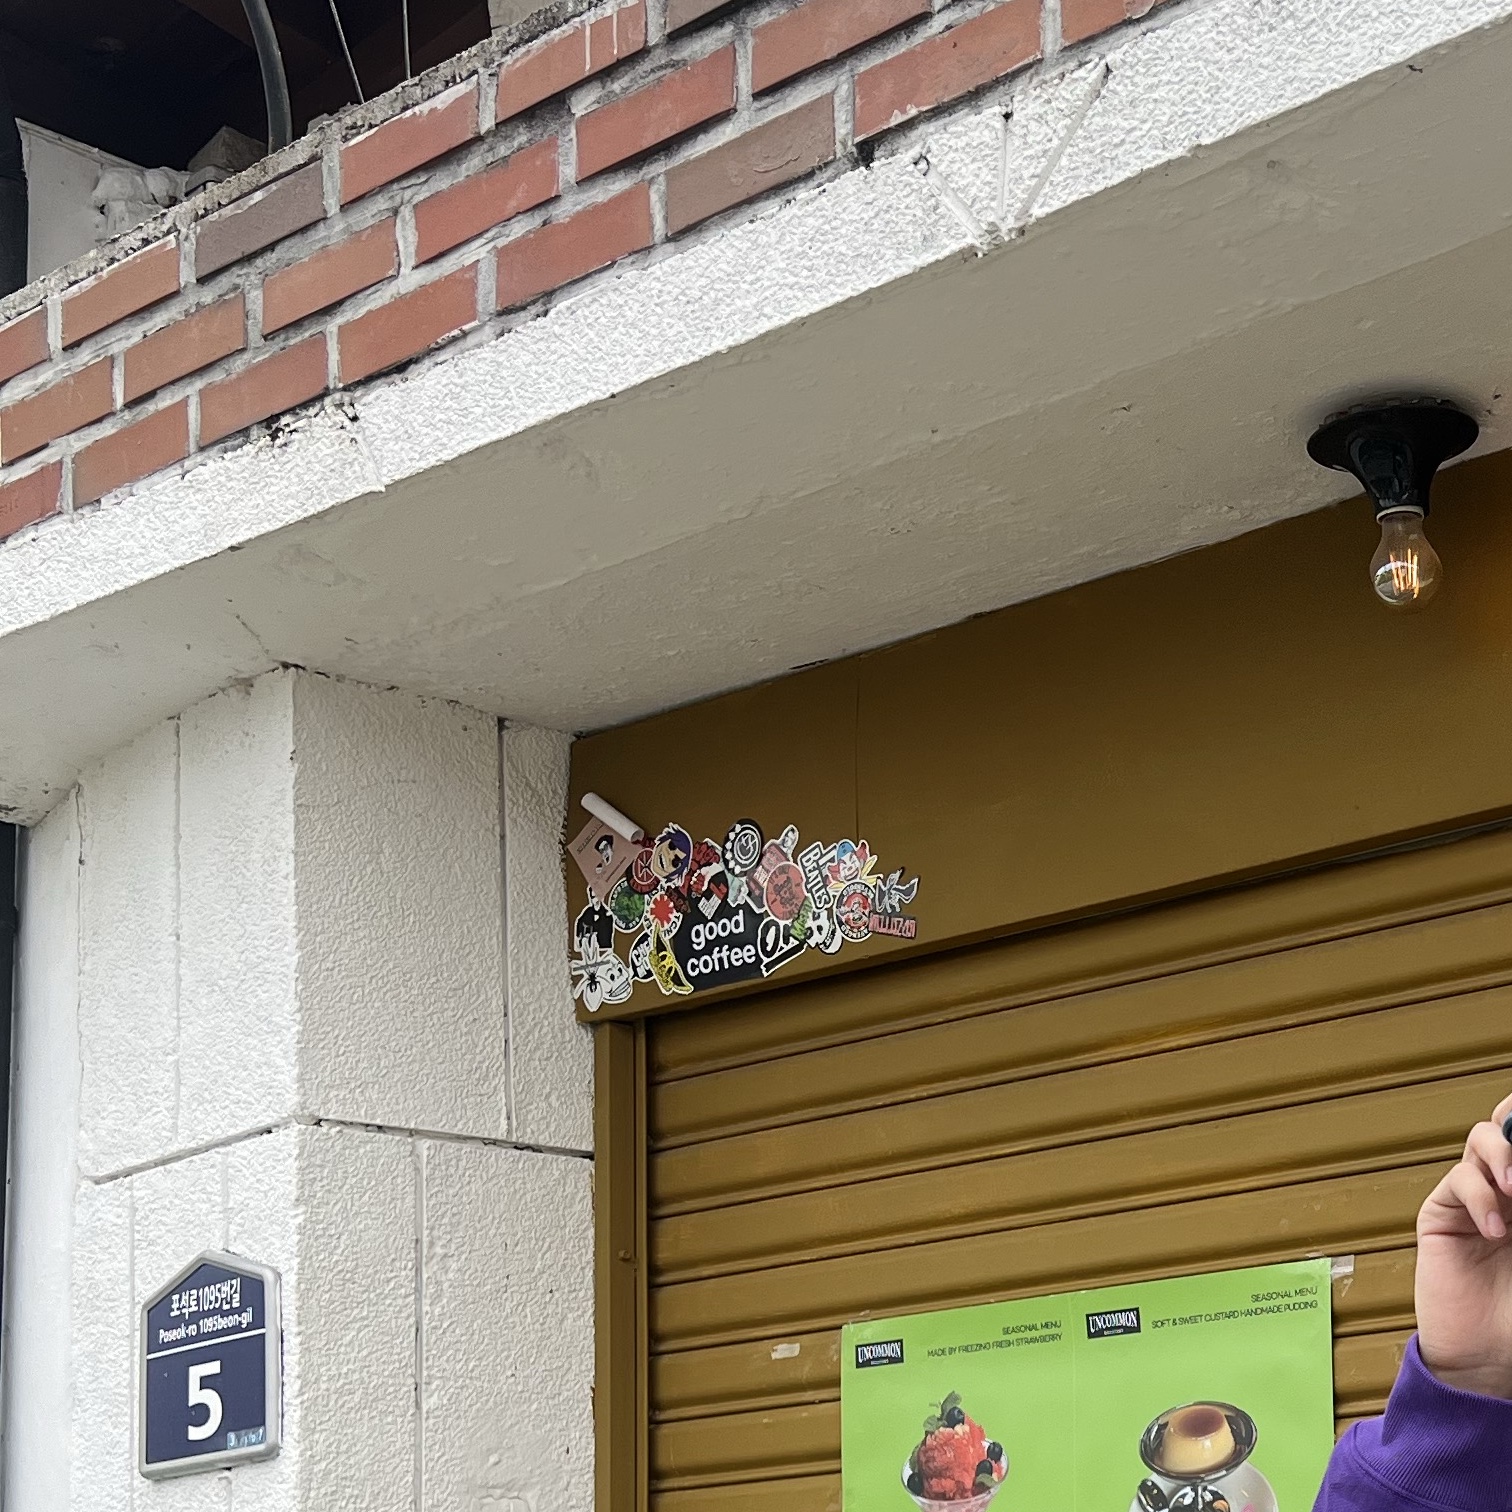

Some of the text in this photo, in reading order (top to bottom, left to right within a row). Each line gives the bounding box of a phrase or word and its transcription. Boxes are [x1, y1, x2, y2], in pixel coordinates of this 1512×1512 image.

[800, 846, 829, 909] BEATLES
[691, 909, 745, 951] good
[686, 944, 756, 977] coffee
[170, 1277, 241, 1320] 포석로1095번길
[1251, 1286, 1318, 1303] SEASONAL MENU
[159, 1306, 253, 1344] Poseok-ro 1095beon-gil
[1002, 1320, 1062, 1336] SEASONAL MENU
[1089, 1310, 1138, 1333] UNCOMMON
[1152, 1300, 1318, 1329] SOFT & SWEET CUSTARD HANDMADE PUDDING
[928, 1348, 948, 1358] MADE
[991, 1338, 1015, 1350] FRESH
[1015, 1333, 1063, 1347] STRAWBERRY
[187, 1360, 223, 1441] 5
